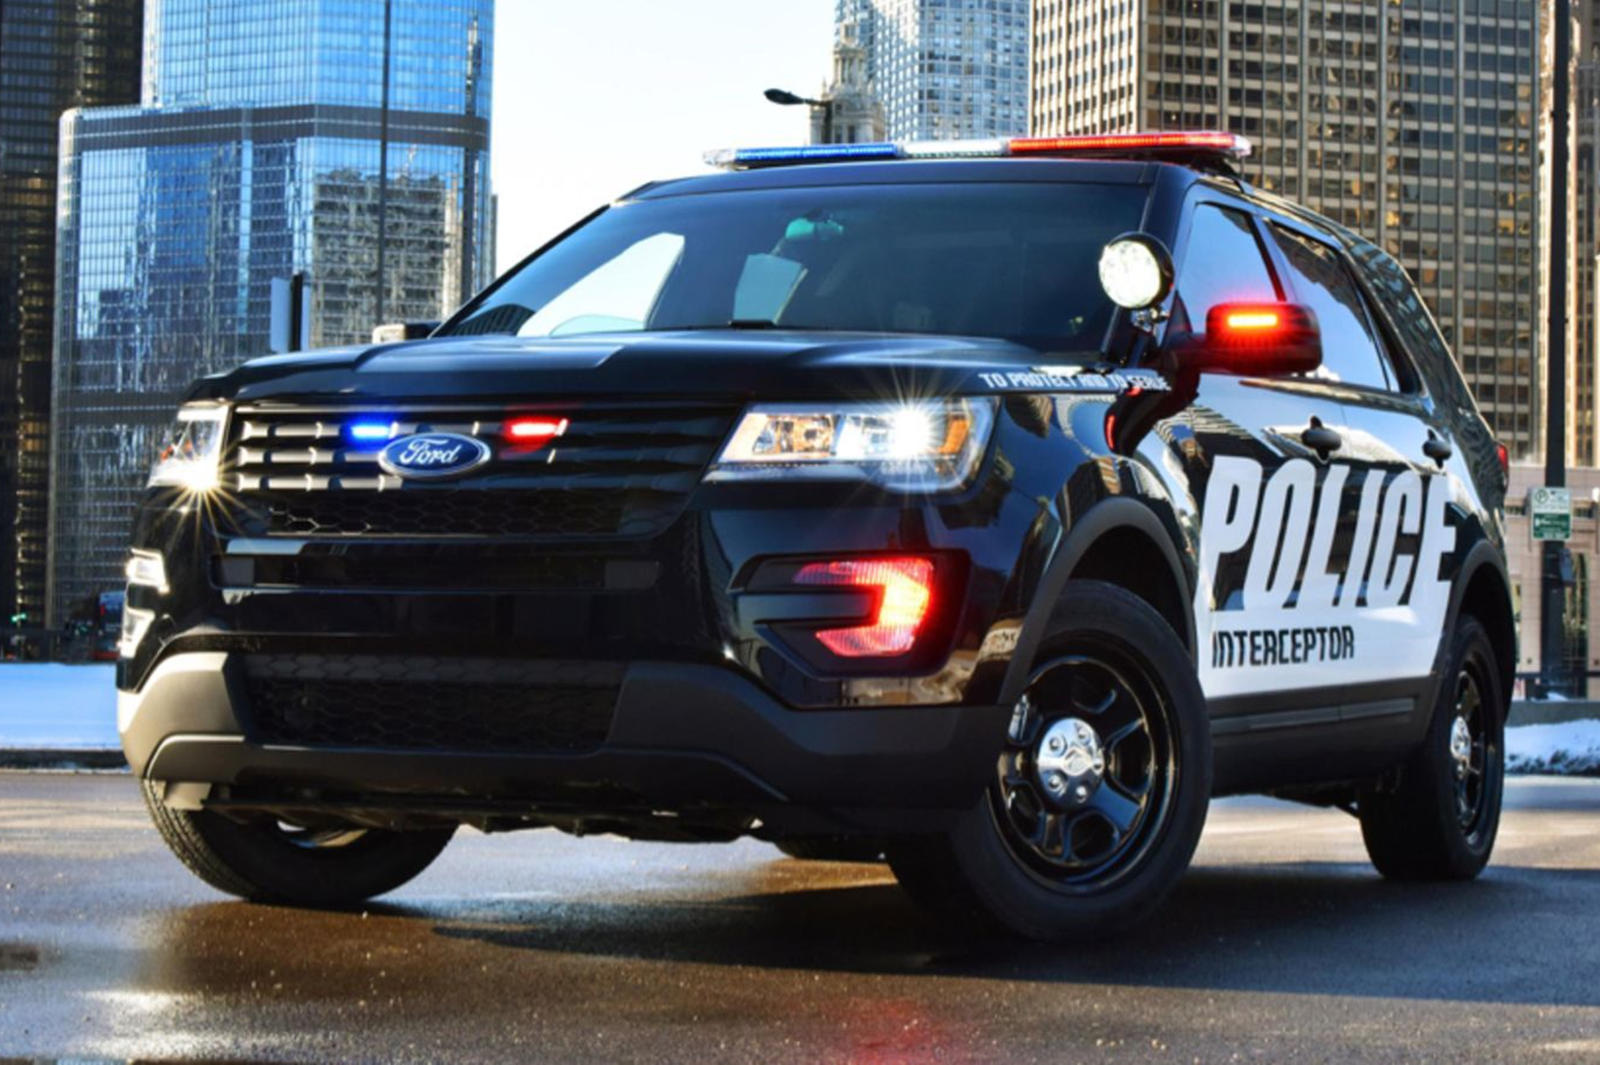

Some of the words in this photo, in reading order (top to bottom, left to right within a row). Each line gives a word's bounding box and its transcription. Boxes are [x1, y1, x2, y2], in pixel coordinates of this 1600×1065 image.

[978, 373, 1007, 388] TO
[1006, 373, 1077, 388] PROTECT
[1077, 374, 1107, 388] AND
[1107, 374, 1127, 389] TO
[399, 438, 462, 465] Ford
[1199, 455, 1456, 612] POLICE
[1212, 625, 1354, 668] INTERCEPTOR
